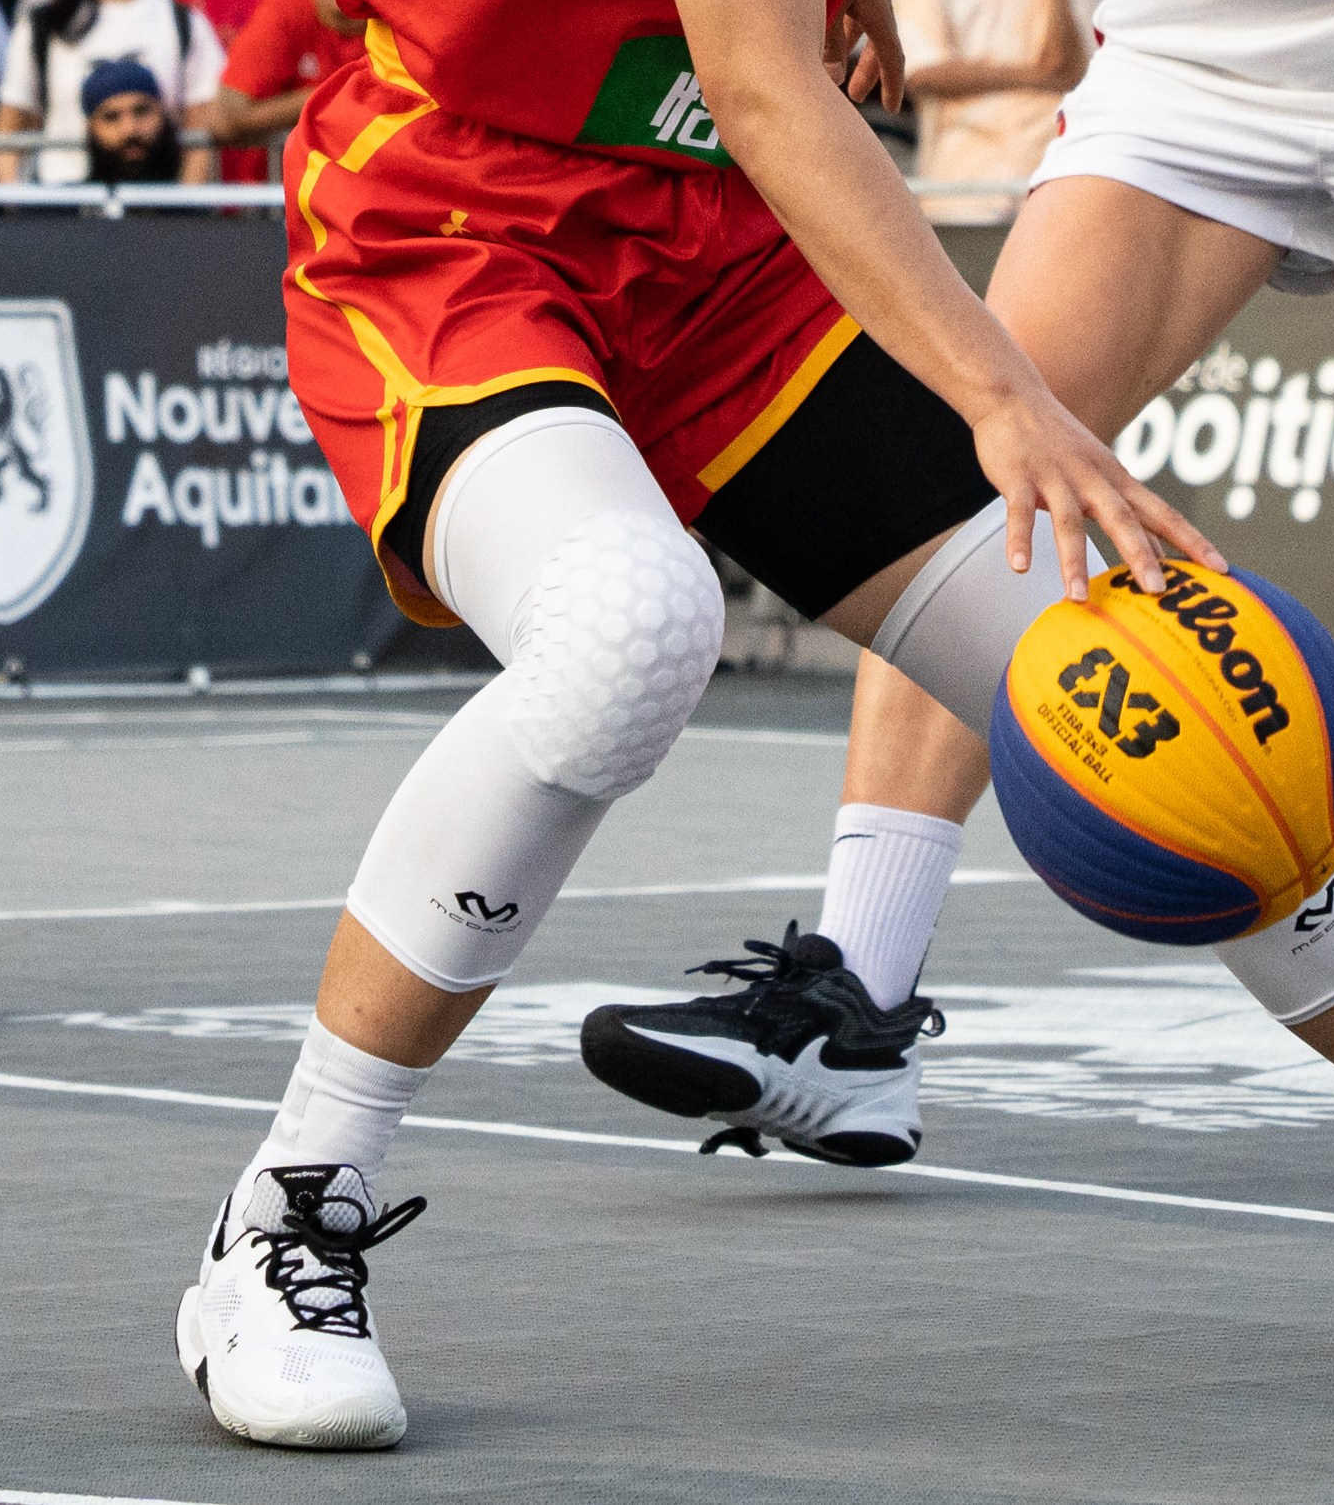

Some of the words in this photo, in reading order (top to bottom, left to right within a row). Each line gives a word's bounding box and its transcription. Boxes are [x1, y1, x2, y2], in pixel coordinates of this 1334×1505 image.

[1037, 702, 1082, 757] OFFICIAL
[1081, 752, 1114, 785] BALL
[1057, 703, 1084, 734] FIBA
